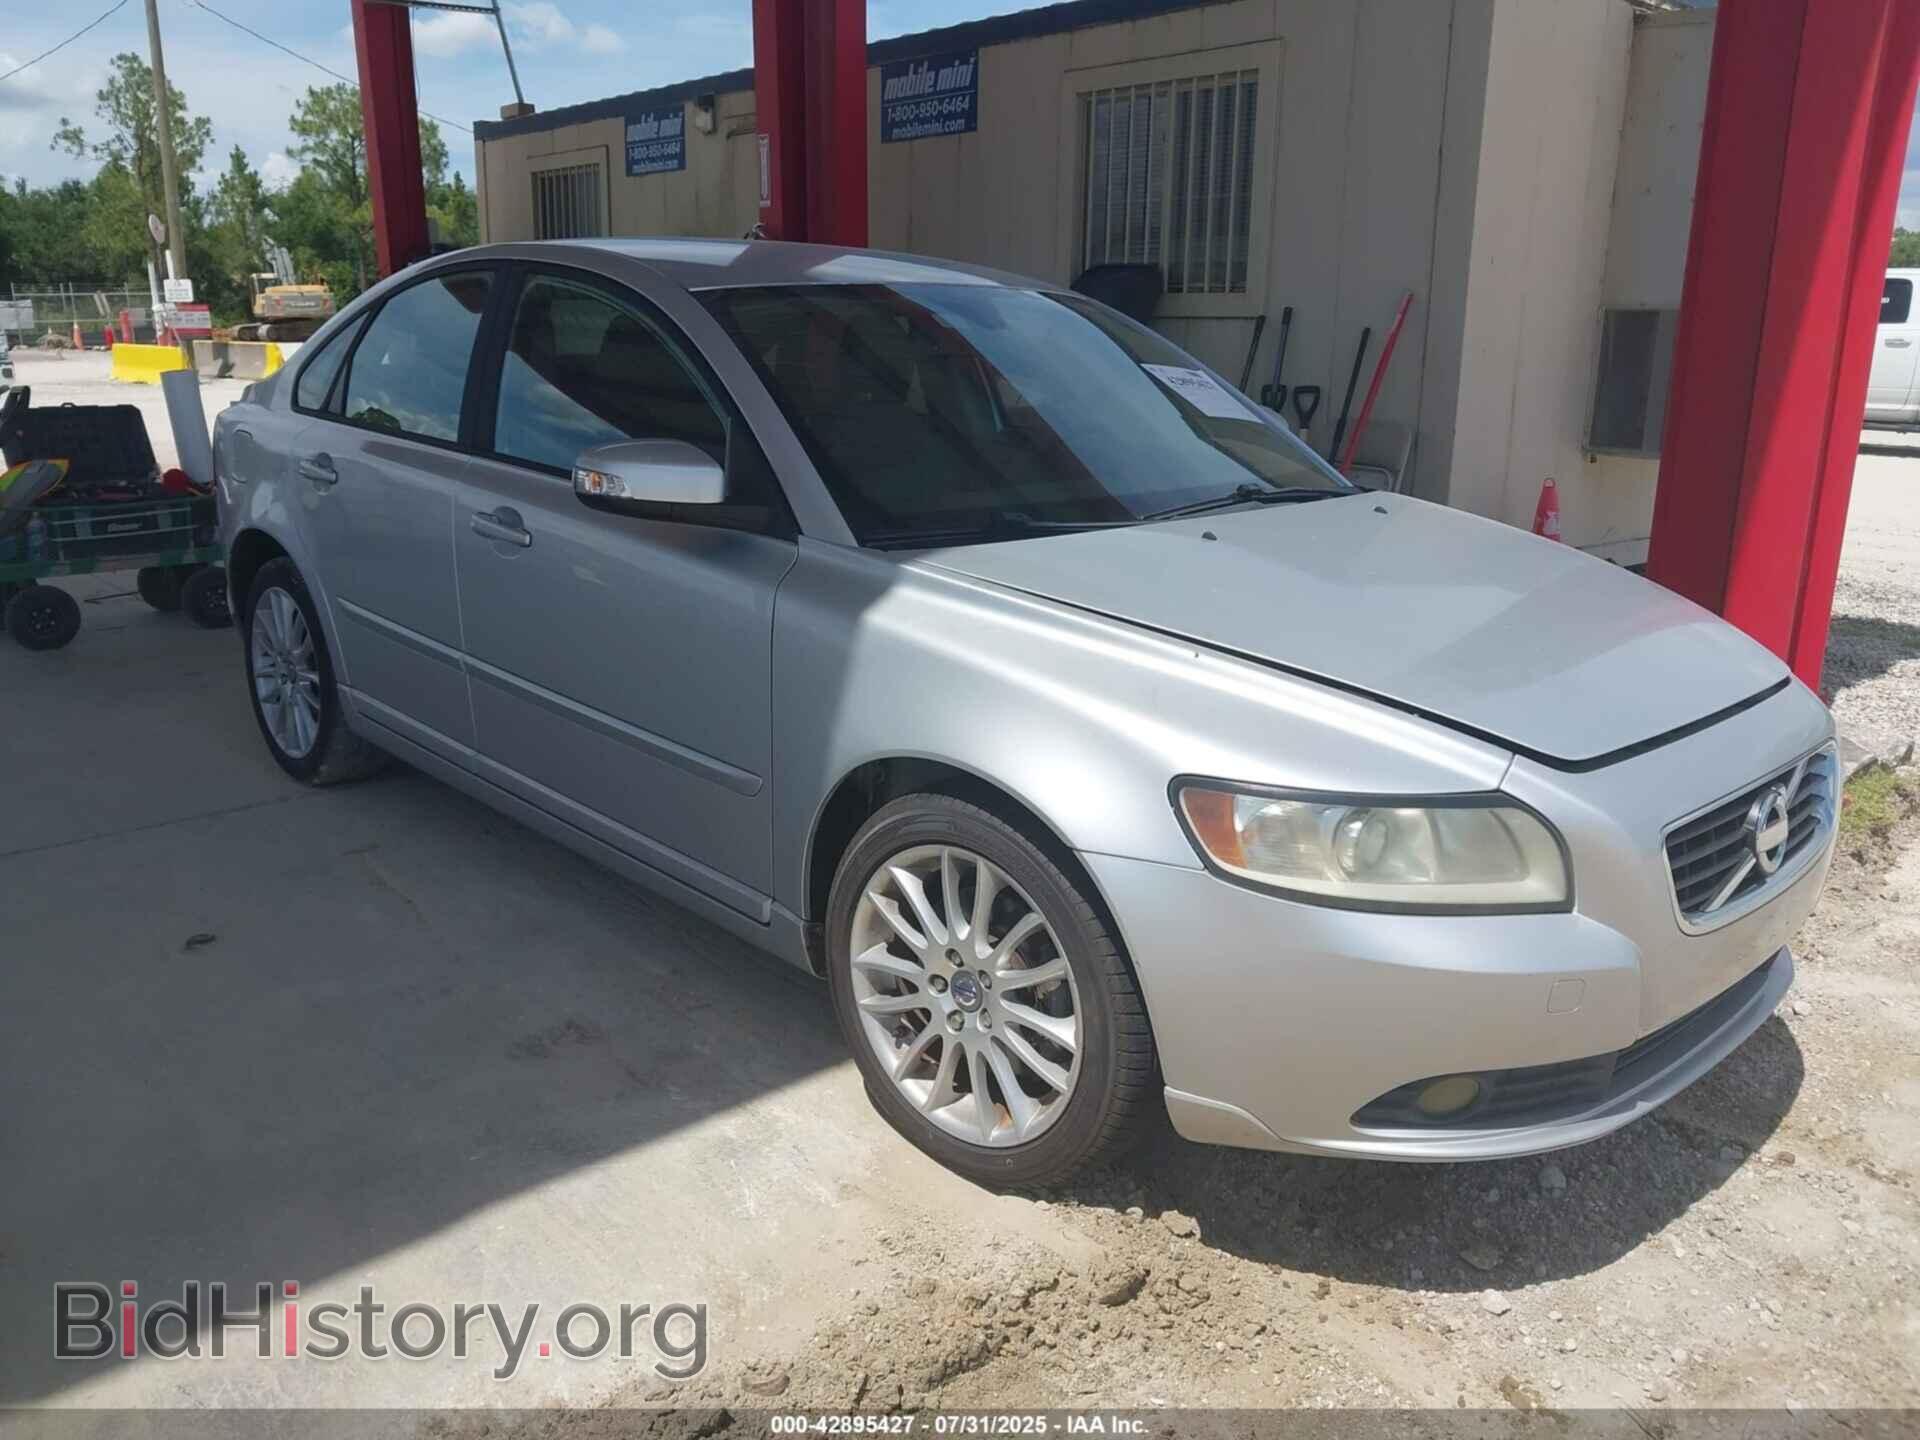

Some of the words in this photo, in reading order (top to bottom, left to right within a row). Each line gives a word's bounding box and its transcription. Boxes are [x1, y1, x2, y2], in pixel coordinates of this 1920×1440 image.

[884, 61, 936, 100] mobile
[937, 57, 975, 91] mini
[888, 95, 970, 123] 1-800-950-6464
